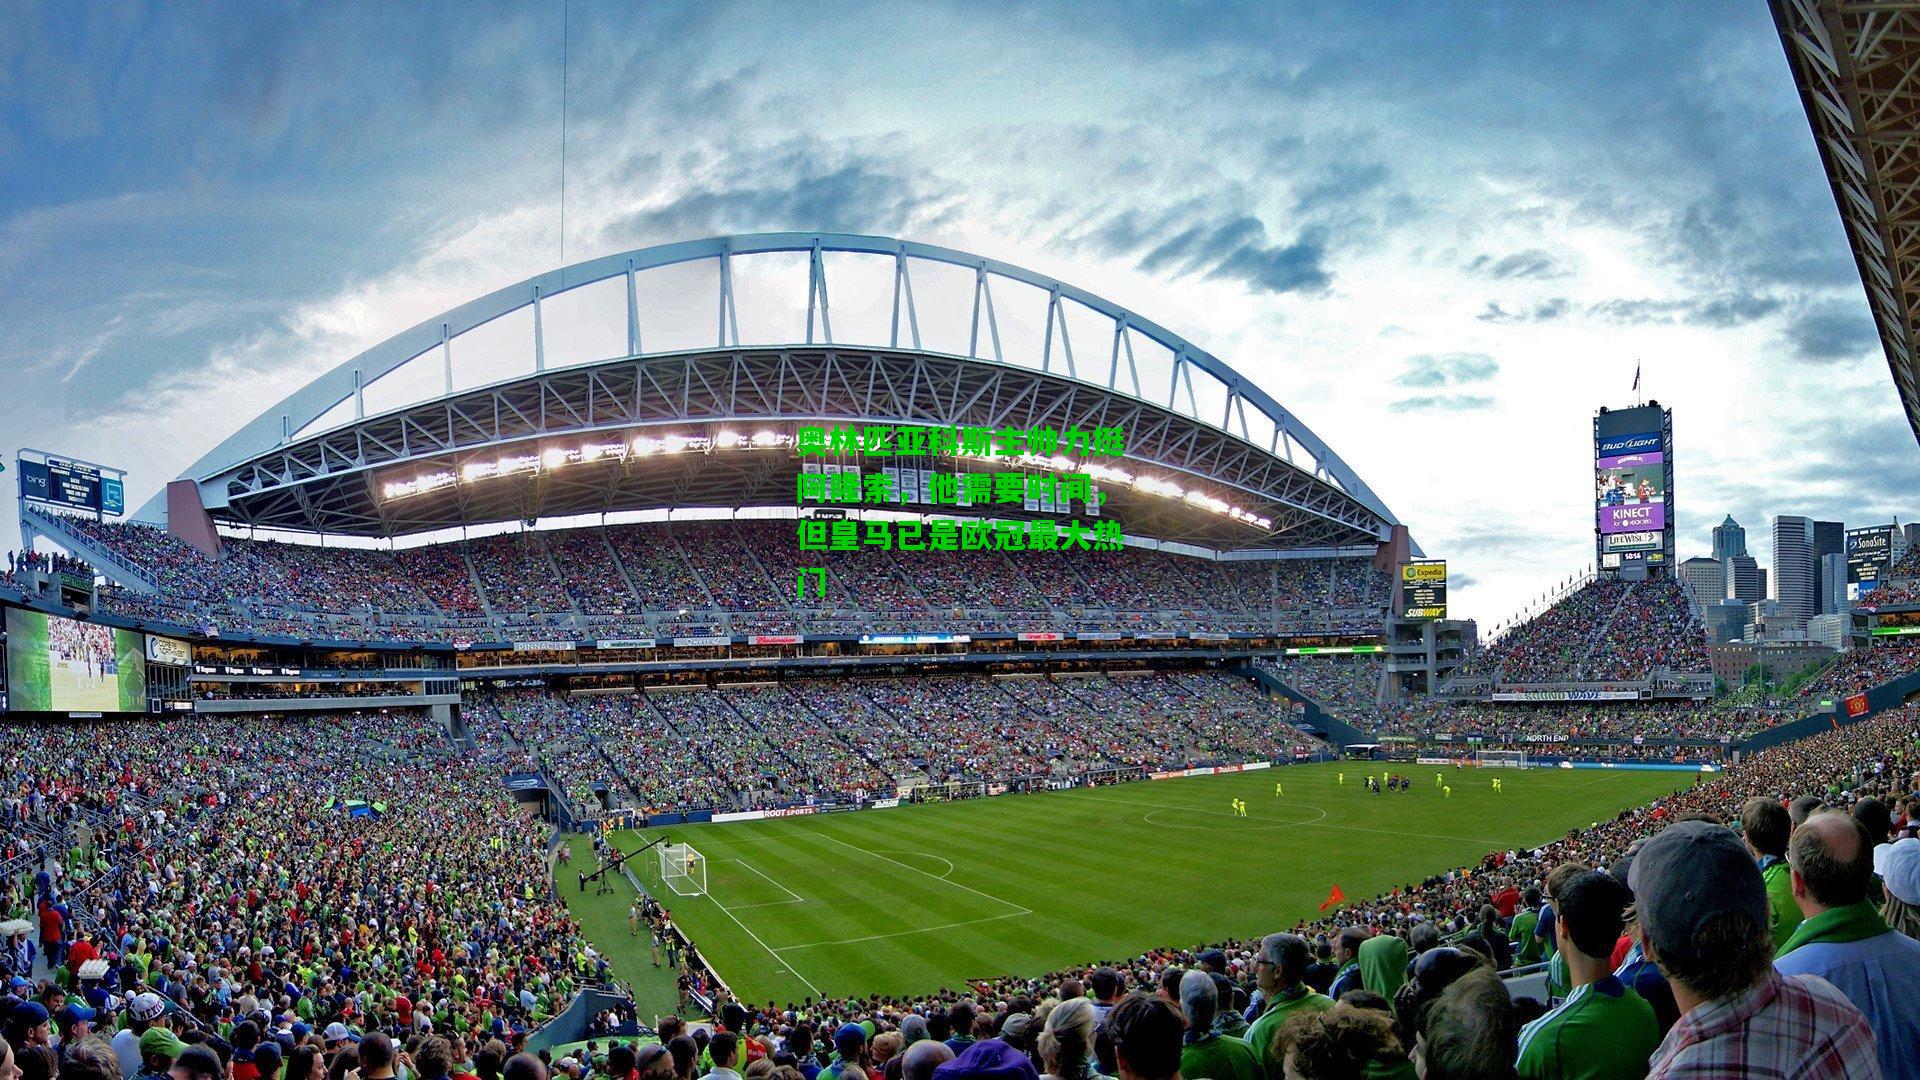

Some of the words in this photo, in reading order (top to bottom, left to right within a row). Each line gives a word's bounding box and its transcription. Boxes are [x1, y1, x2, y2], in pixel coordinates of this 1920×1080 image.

[26, 474, 46, 487] bing
[1613, 506, 1653, 519] KINECT
[1858, 536, 1886, 548] SonoSite
[1417, 569, 1442, 577] Expedia
[1405, 608, 1445, 618] SUBWAY
[611, 640, 651, 649] walottery.com
[757, 635, 796, 644] Budweiser
[518, 642, 564, 651] PINNACLE
[1526, 734, 1553, 743] NORTH
[1553, 733, 1570, 742] END
[764, 808, 786, 818] ROOT
[786, 807, 813, 817] SPORTS
